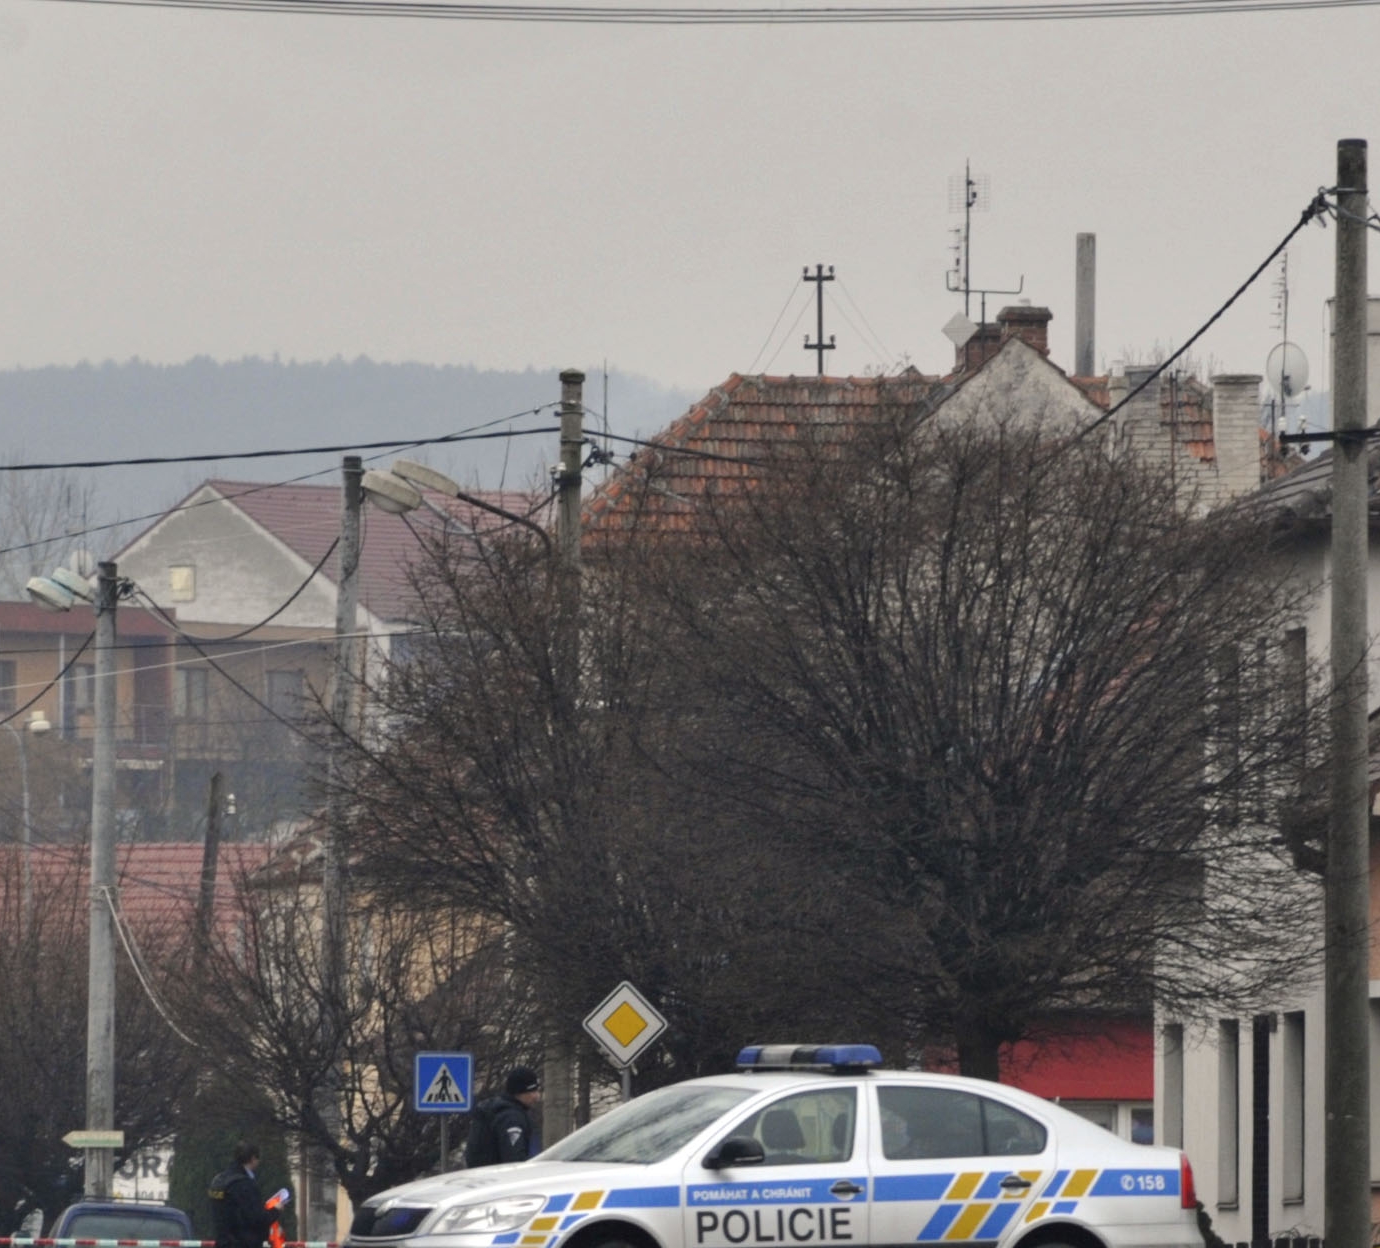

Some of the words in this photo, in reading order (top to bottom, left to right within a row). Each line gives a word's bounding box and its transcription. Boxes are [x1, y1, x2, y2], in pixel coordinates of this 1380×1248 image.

[1136, 1174, 1165, 1191] 158
[693, 1186, 748, 1201] POMÁHAT
[751, 1189, 761, 1200] A
[762, 1185, 813, 1200] CHRÁNIT
[696, 1207, 853, 1244] POLICIE
